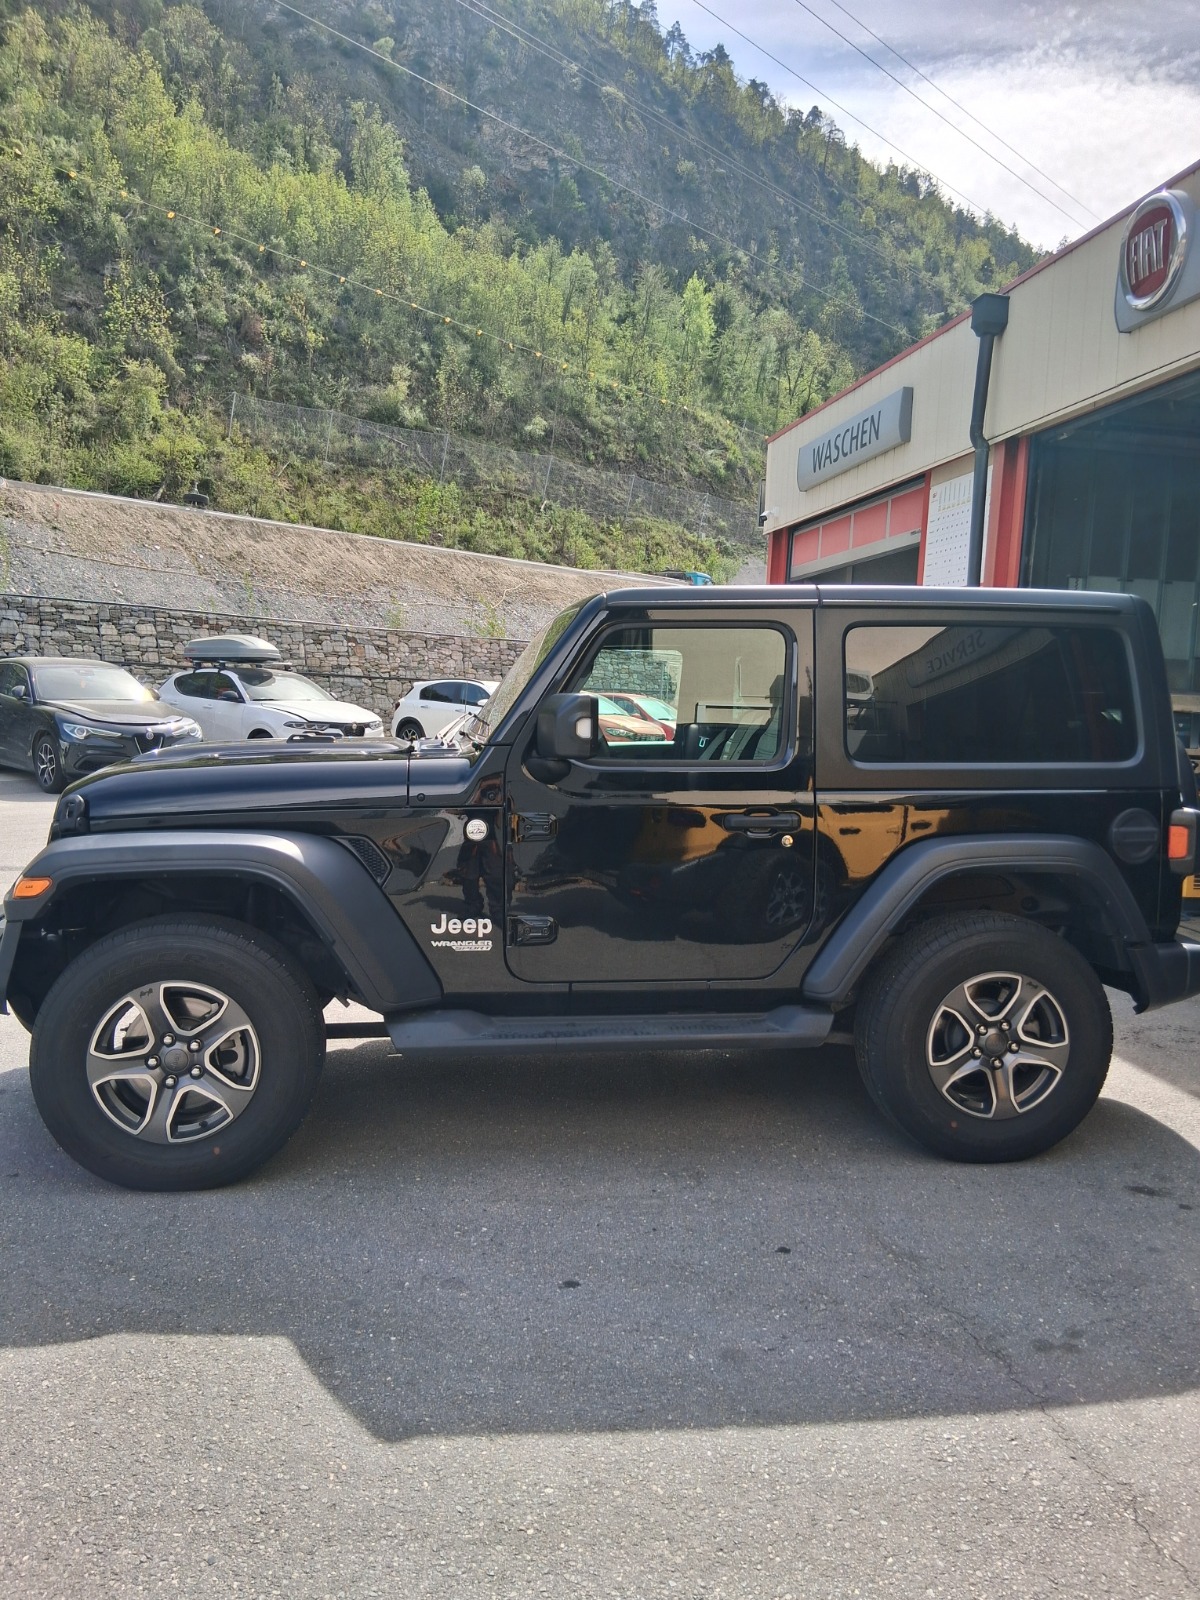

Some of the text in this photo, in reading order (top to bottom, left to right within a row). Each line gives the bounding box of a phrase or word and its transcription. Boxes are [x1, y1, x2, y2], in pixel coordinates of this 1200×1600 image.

[1129, 218, 1167, 285] FIAT
[812, 410, 881, 473] WASCHEN
[430, 913, 493, 938] Jeep
